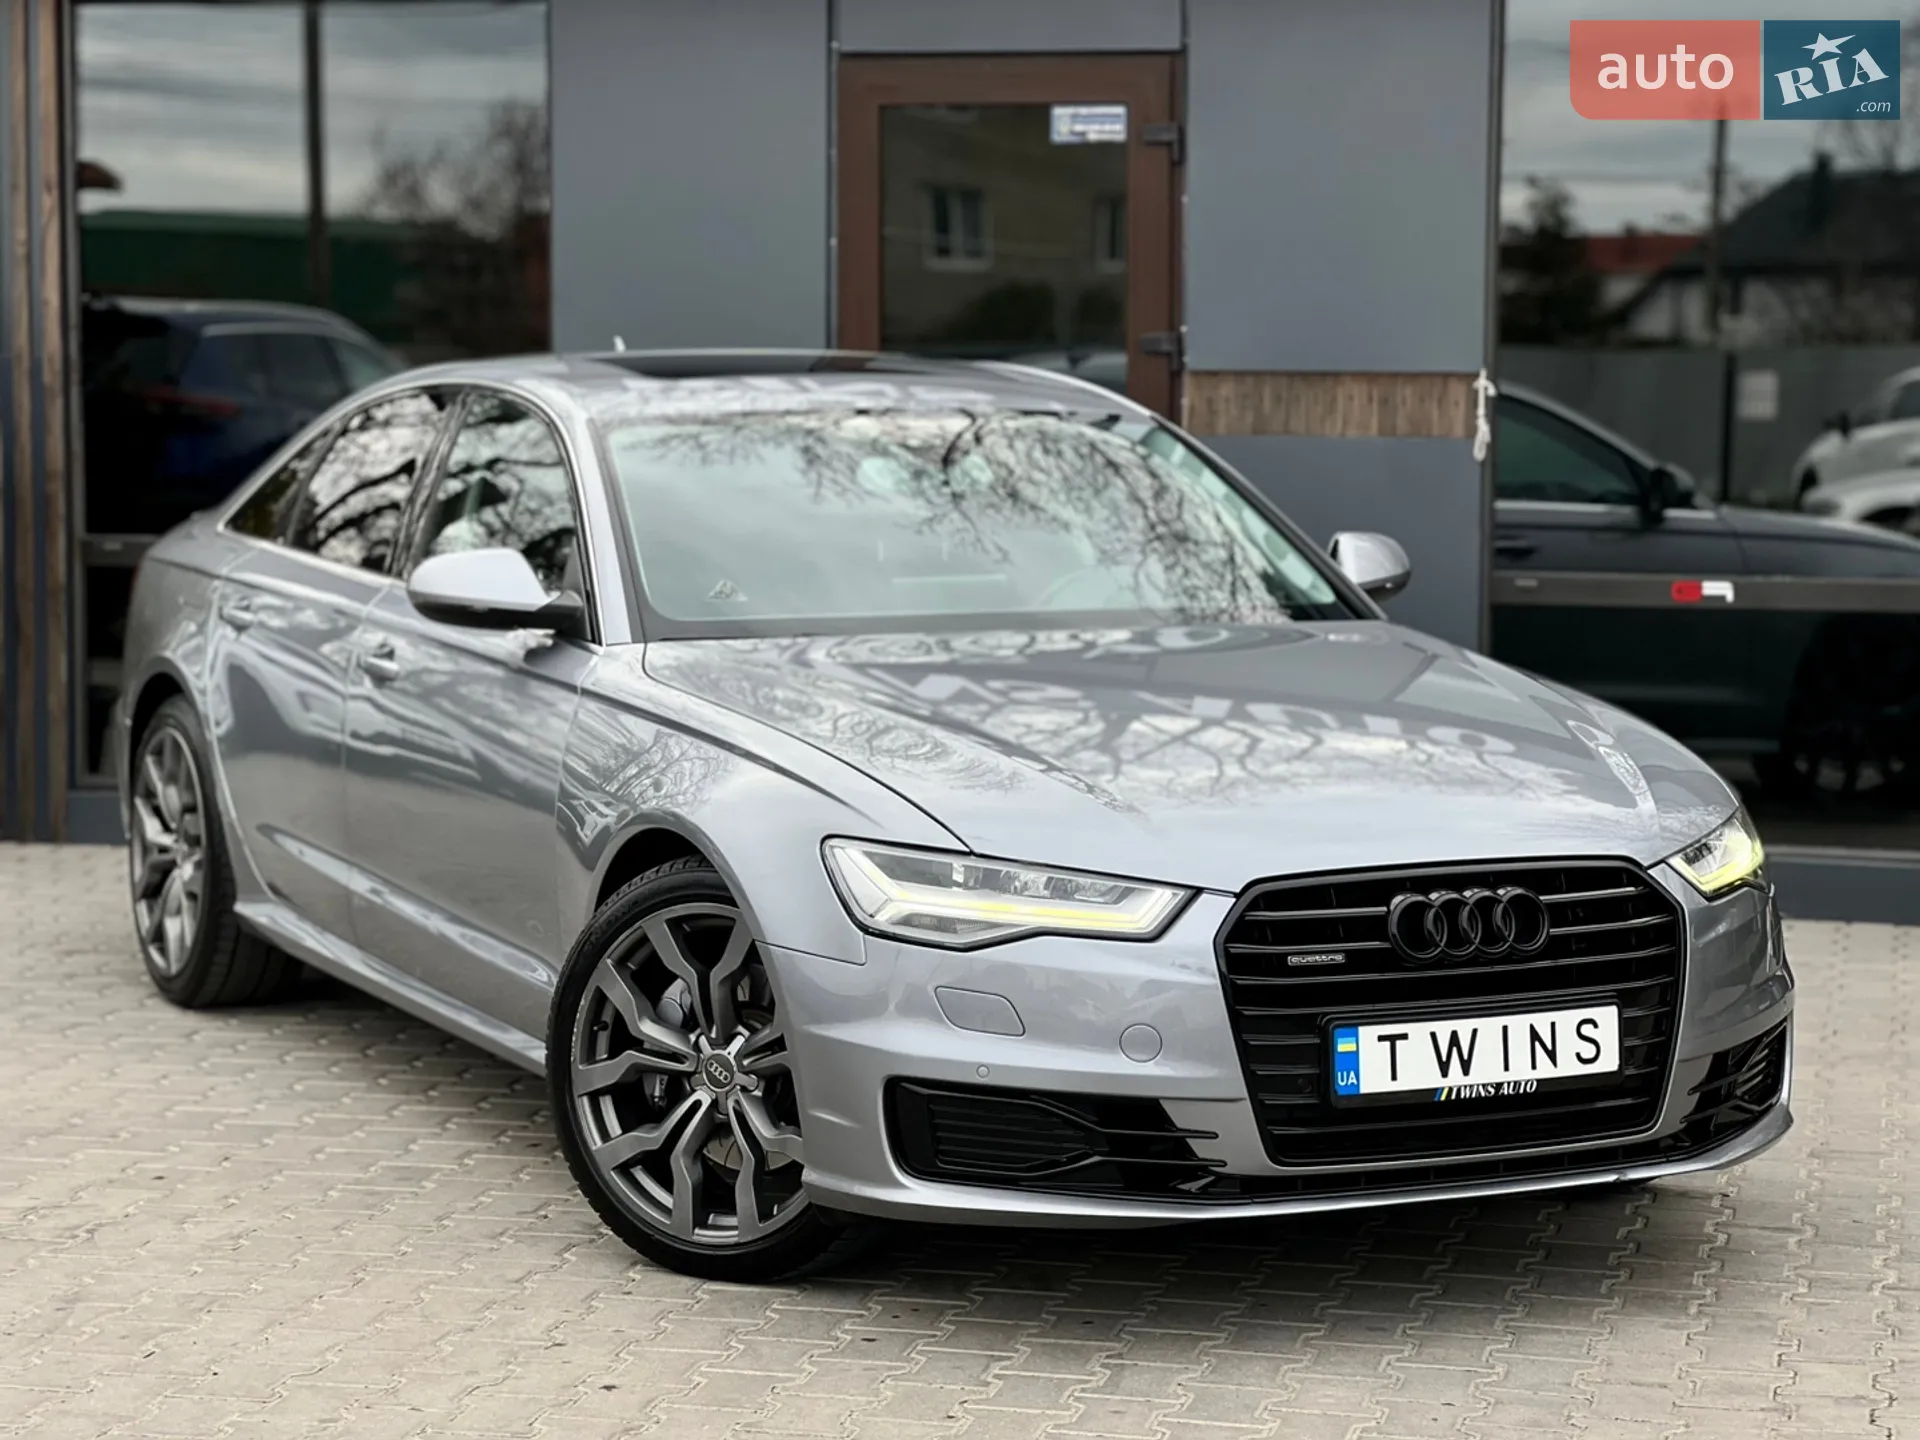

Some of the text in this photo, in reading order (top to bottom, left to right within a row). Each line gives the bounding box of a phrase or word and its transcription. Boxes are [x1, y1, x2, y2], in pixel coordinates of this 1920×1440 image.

[1377, 1018, 1600, 1082] TWINS
[1337, 1071, 1358, 1087] UA
[1451, 1080, 1537, 1100] TWINS AUTO
